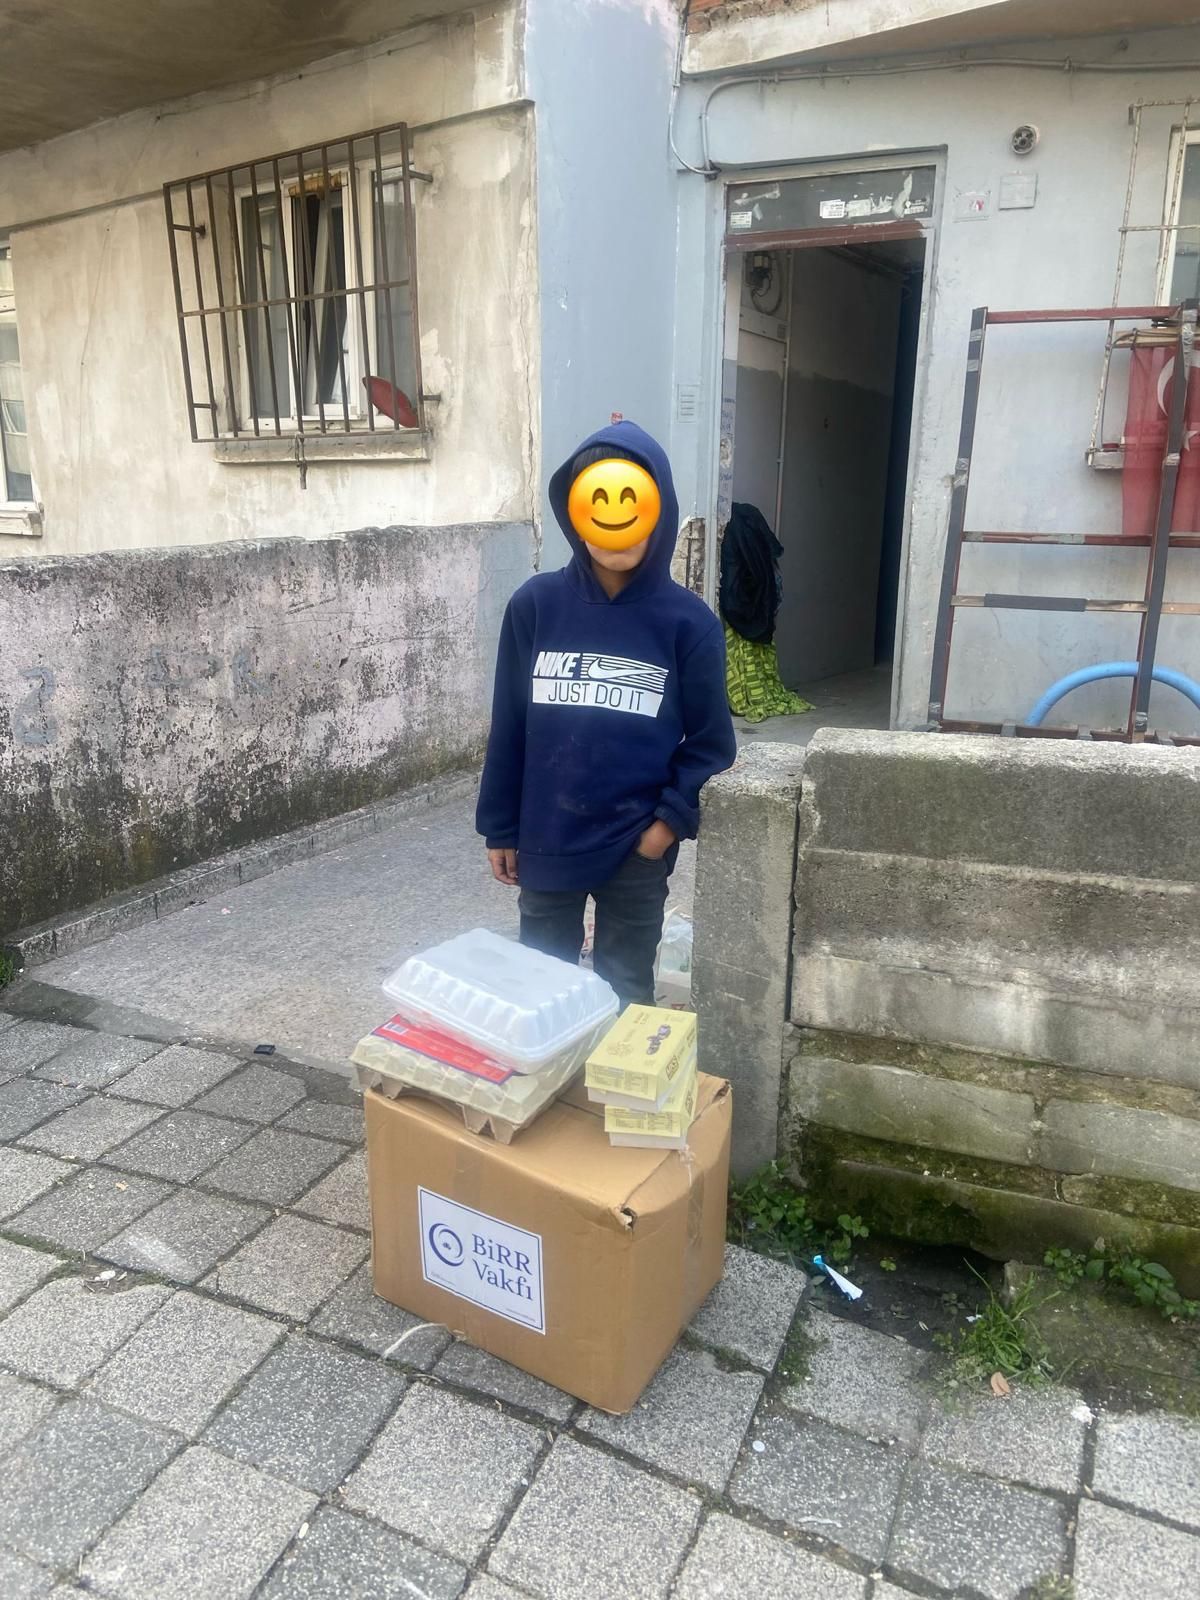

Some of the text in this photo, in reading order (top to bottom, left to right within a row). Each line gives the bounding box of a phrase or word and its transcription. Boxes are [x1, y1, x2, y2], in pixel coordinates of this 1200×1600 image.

[533, 651, 581, 678] NIKE
[548, 682, 644, 711] JUST DO IT
[471, 1233, 533, 1276] BiRR
[472, 1258, 534, 1301] Vakfı
